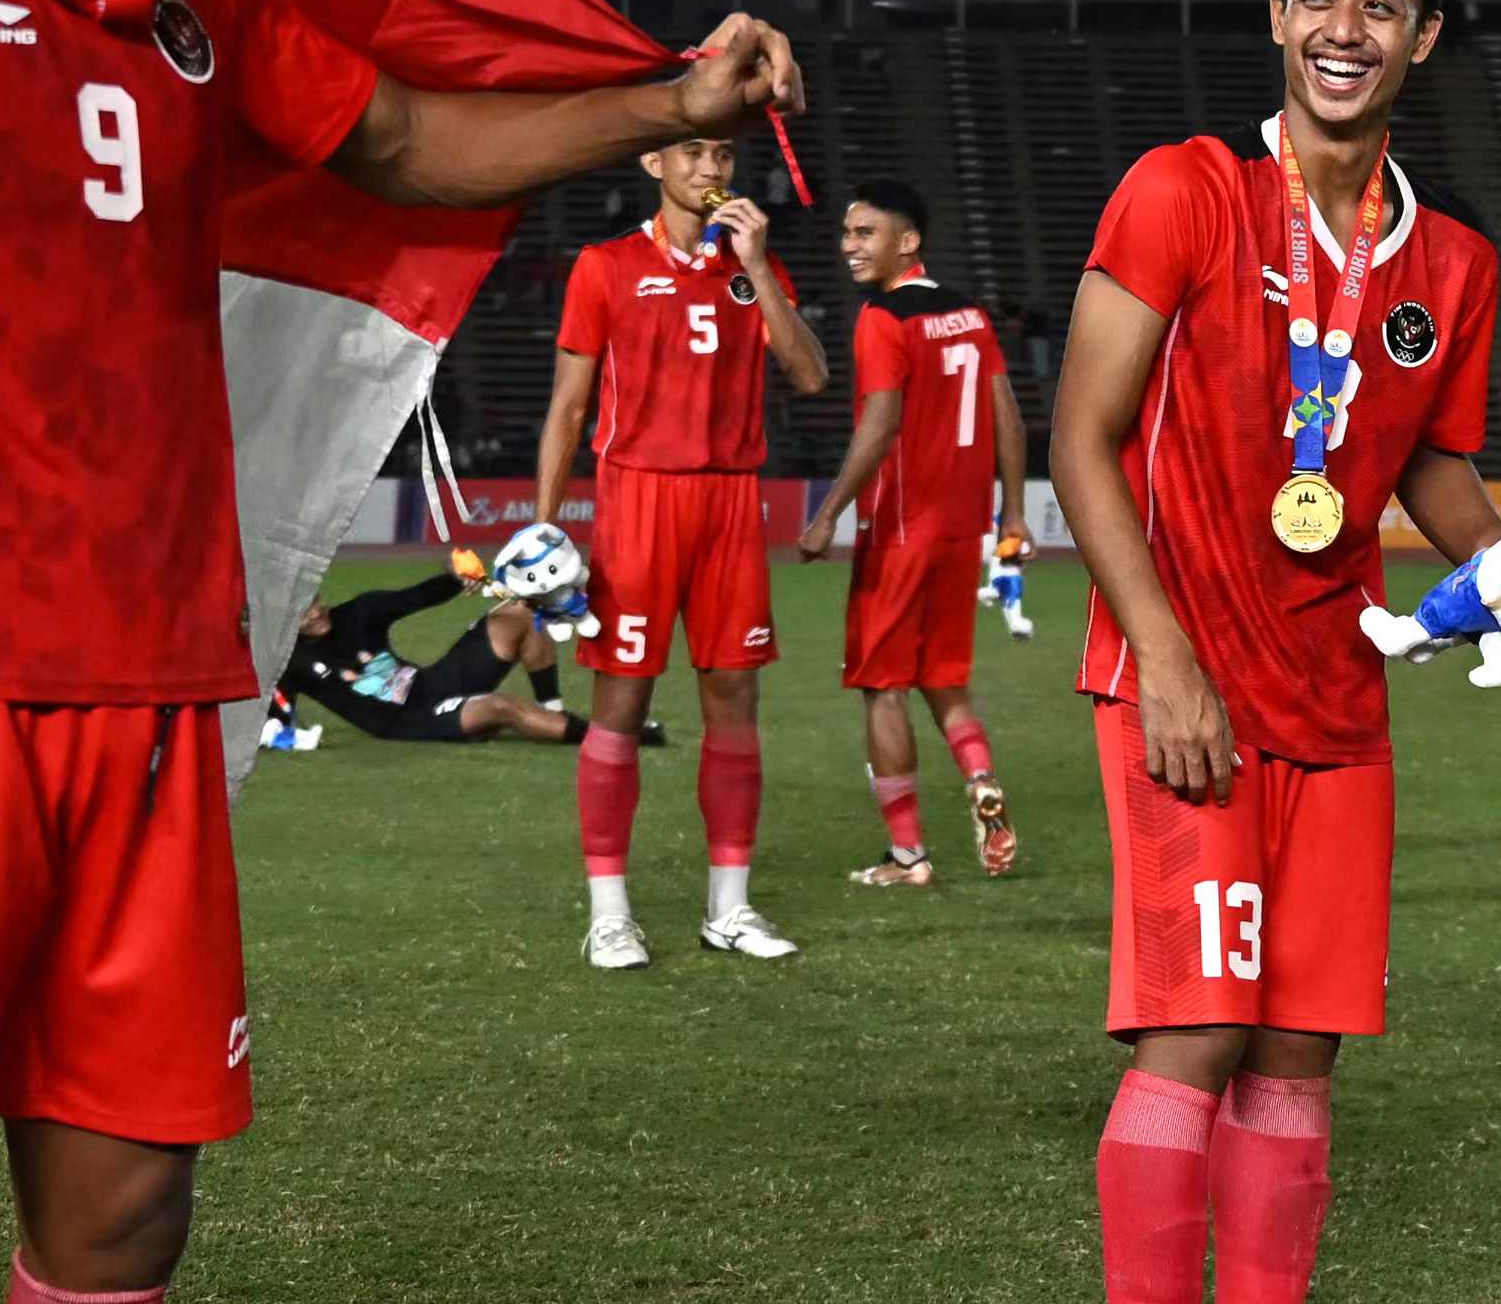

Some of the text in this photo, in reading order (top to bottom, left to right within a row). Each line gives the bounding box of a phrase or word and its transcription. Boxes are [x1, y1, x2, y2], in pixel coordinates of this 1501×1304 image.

[77, 82, 144, 222] 9
[1285, 158, 1301, 175] IN
[1288, 179, 1305, 213] LIVE
[1291, 219, 1309, 284] SPORTS
[1343, 177, 1381, 299] SPORTS LIVE IN
[688, 304, 719, 354] 5
[942, 343, 981, 447] 7
[502, 500, 595, 521] ANOR
[615, 614, 648, 663] 5
[1193, 880, 1263, 981] 13
